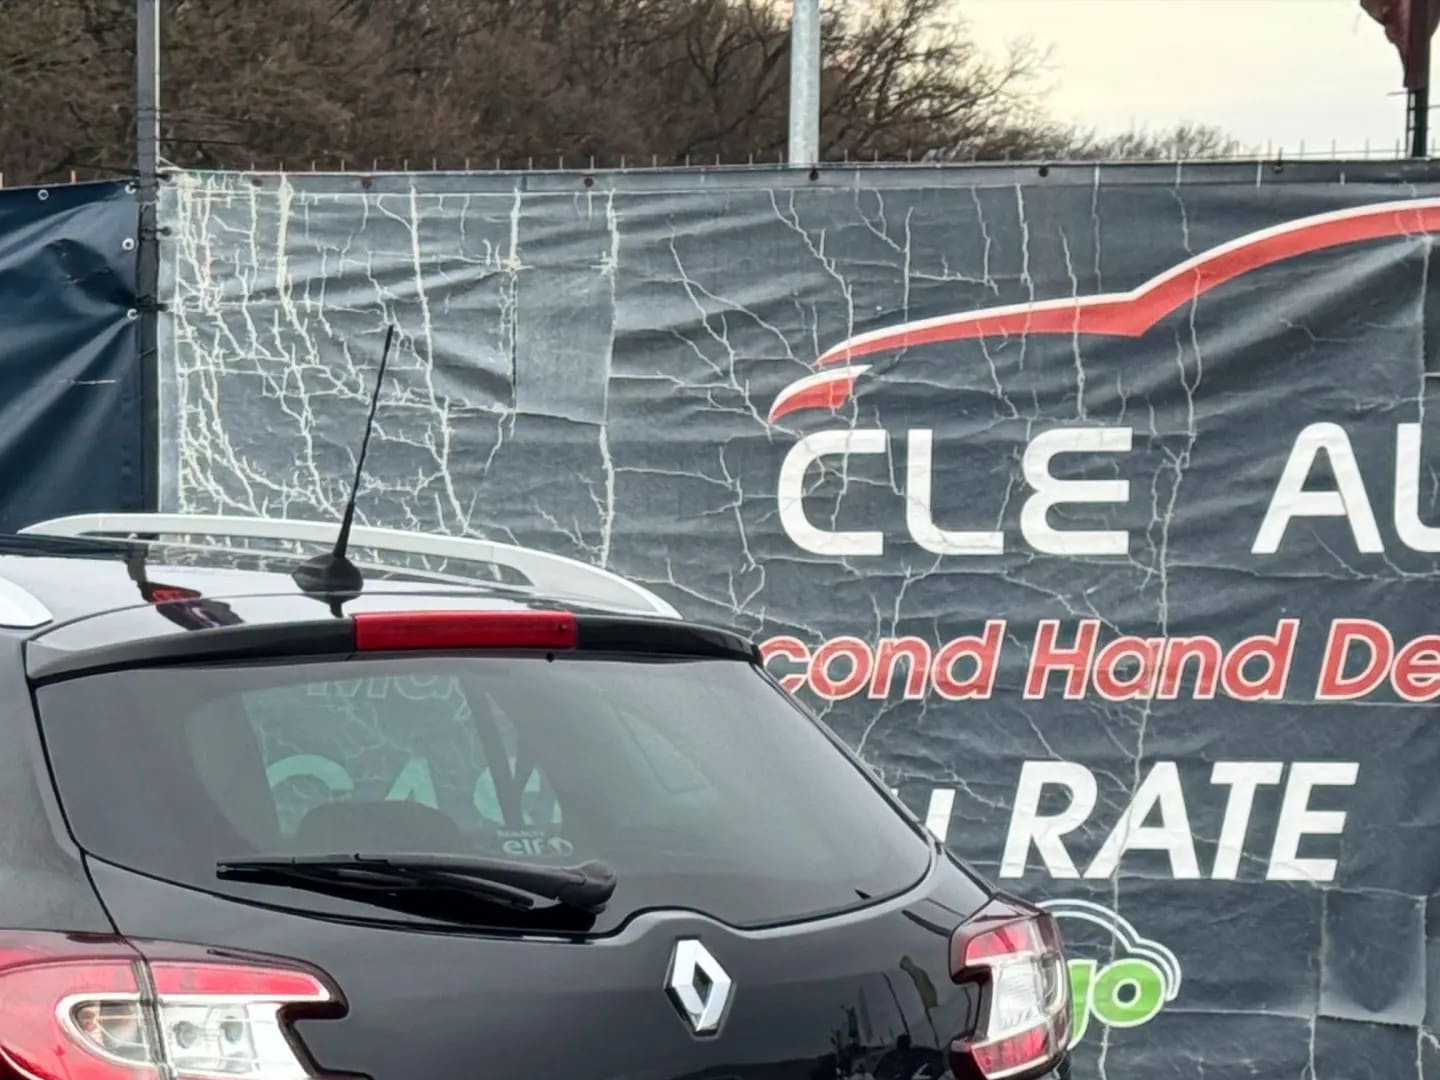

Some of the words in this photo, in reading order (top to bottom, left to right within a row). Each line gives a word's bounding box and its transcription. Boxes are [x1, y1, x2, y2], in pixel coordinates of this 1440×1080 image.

[776, 427, 1134, 557] CLE
[1022, 619, 1300, 701] Hand
[1315, 619, 1440, 701] De
[999, 761, 1360, 881] RATE
